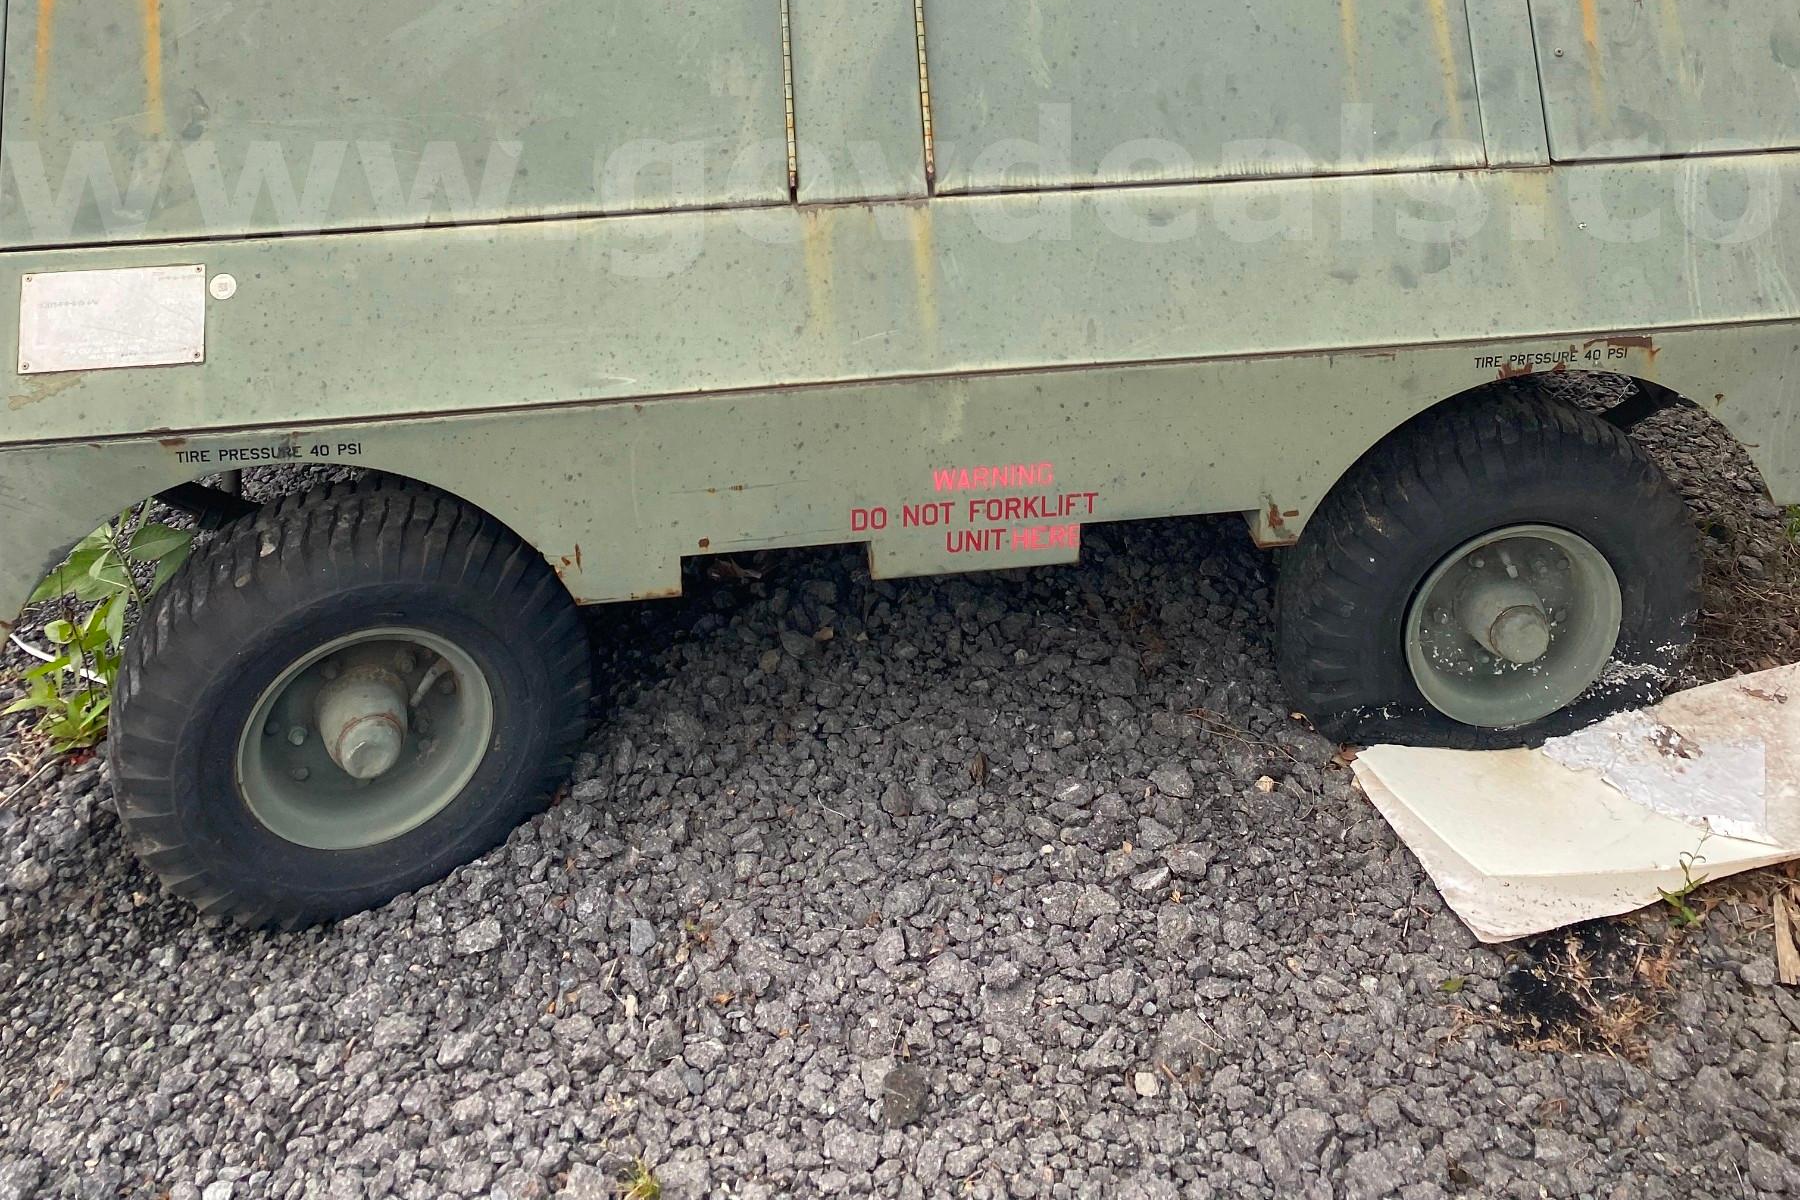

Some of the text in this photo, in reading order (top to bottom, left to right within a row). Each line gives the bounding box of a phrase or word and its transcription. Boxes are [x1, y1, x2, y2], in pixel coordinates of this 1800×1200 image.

[1475, 348, 1628, 369] TIRE PRESSURE 40 PSI
[176, 443, 362, 463] TIRE PRESSURE 40 PSI
[933, 462, 1054, 492] WARNING
[851, 492, 1099, 532] DO NOT FORKLIFT
[946, 523, 1080, 553] UNIT HERE
